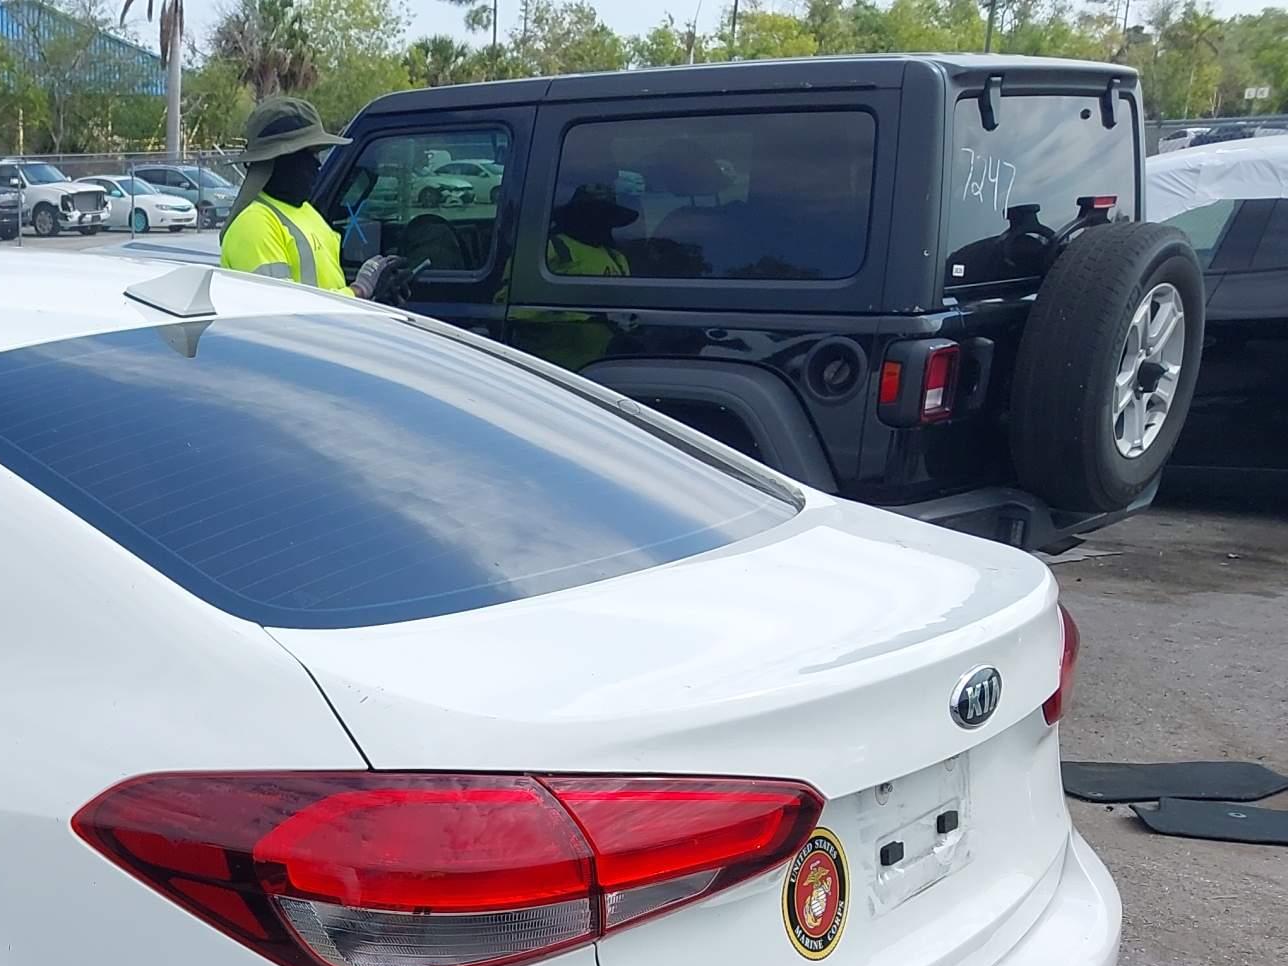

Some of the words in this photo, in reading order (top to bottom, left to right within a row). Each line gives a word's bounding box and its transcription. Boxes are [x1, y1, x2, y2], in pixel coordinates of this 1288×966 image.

[961, 147, 1017, 219] 7247
[966, 676, 1000, 720] KIA
[790, 842, 813, 883] UNITED
[814, 839, 838, 861] STATES
[794, 925, 824, 950] MARINE
[827, 899, 845, 941] CORPS
